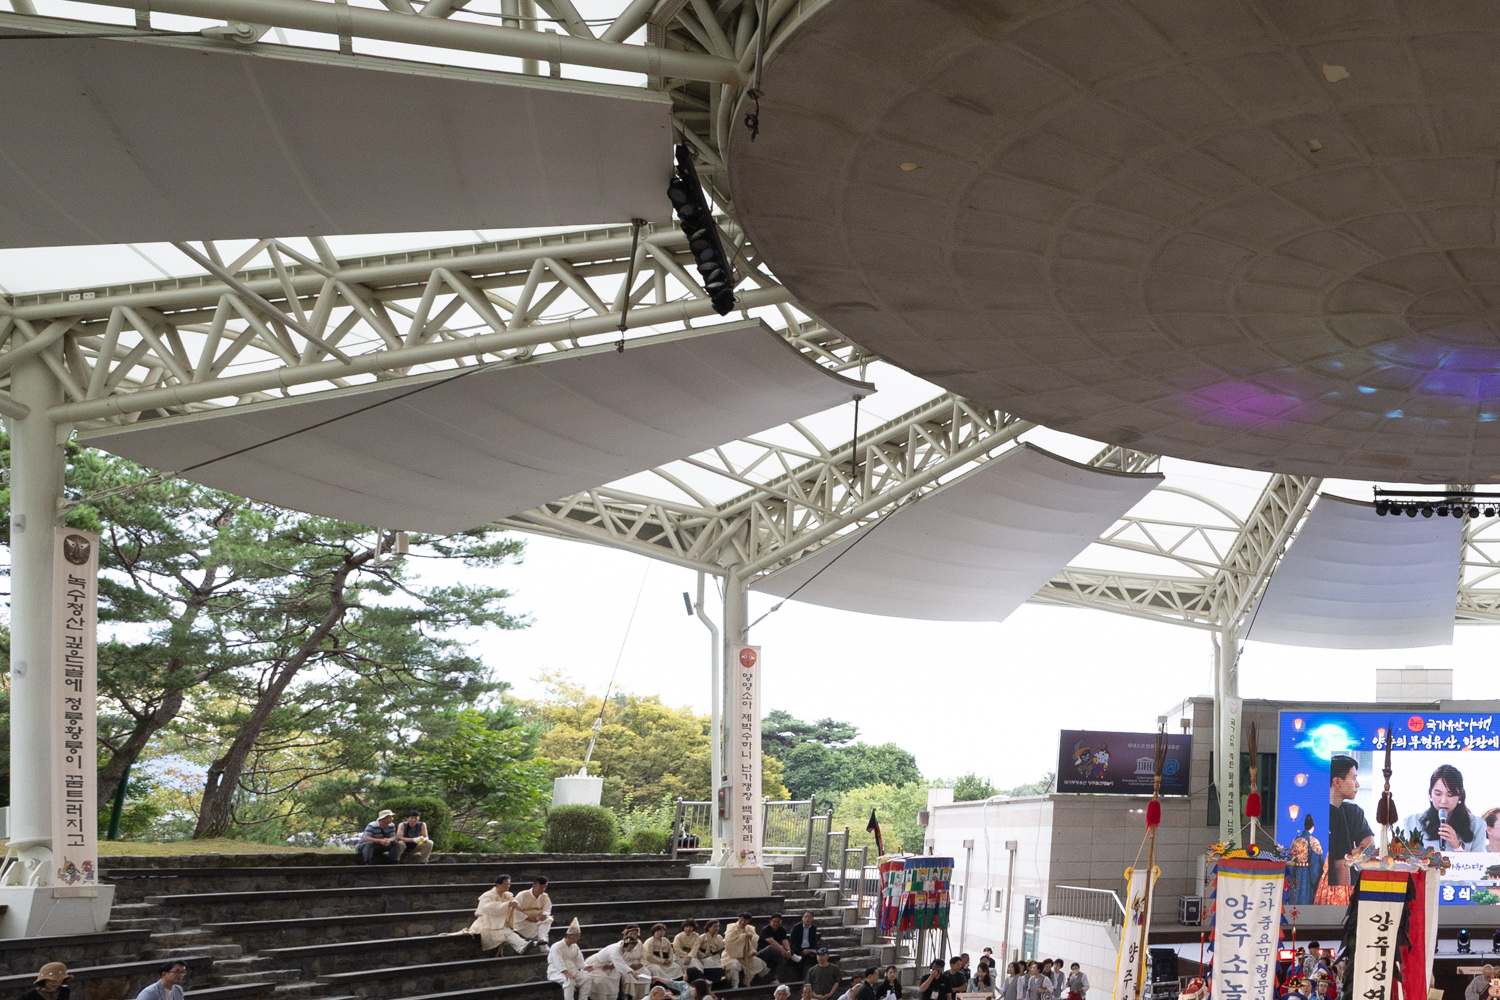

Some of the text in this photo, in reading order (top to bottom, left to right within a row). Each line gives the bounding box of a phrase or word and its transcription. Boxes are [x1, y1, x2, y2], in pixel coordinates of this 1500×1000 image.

[64, 573, 86, 847] 녹수청산 깊은골에 청룡황룡이 꿈트러지고
[741, 713, 753, 760] 제박수하니
[1409, 735, 1461, 749] 무형유산,
